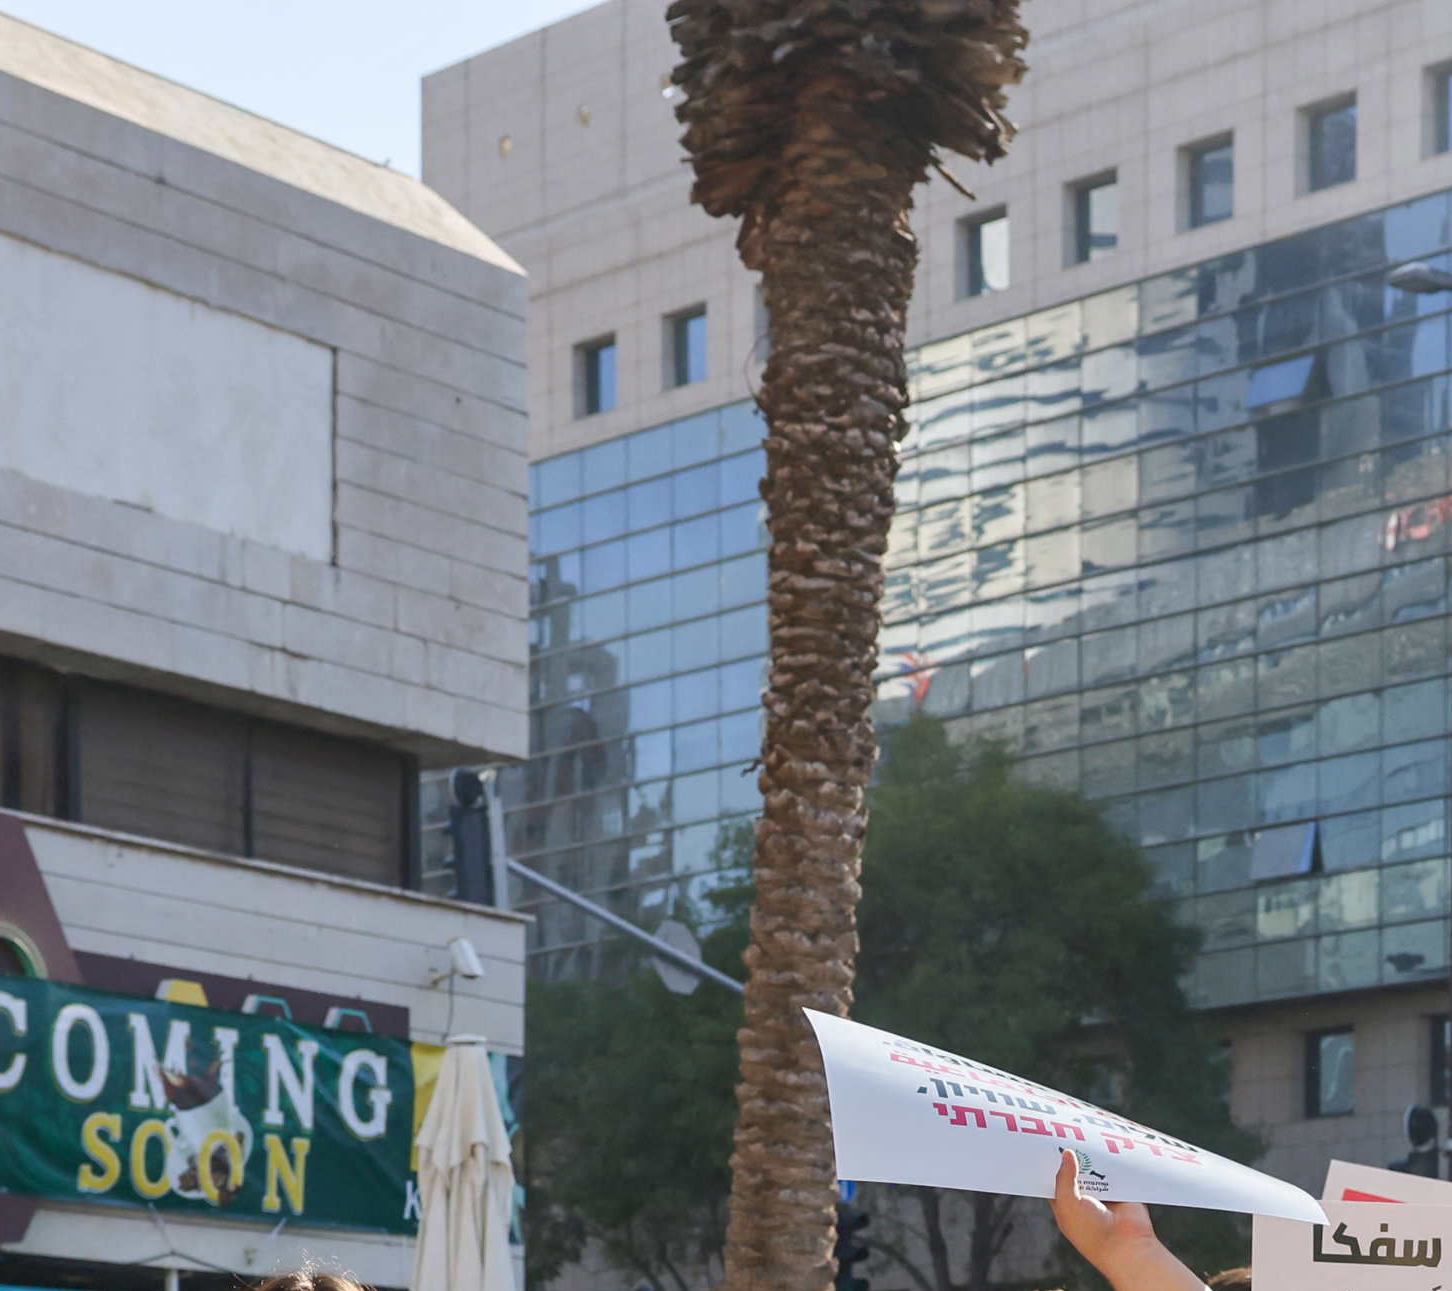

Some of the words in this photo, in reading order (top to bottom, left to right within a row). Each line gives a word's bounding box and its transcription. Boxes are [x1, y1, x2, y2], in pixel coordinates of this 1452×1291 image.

[932, 1102, 1087, 1142] חברתי
[77, 1112, 311, 1216] SOON
[1099, 1131, 1203, 1165] צדק
[1311, 1220, 1443, 1269] سفكا
